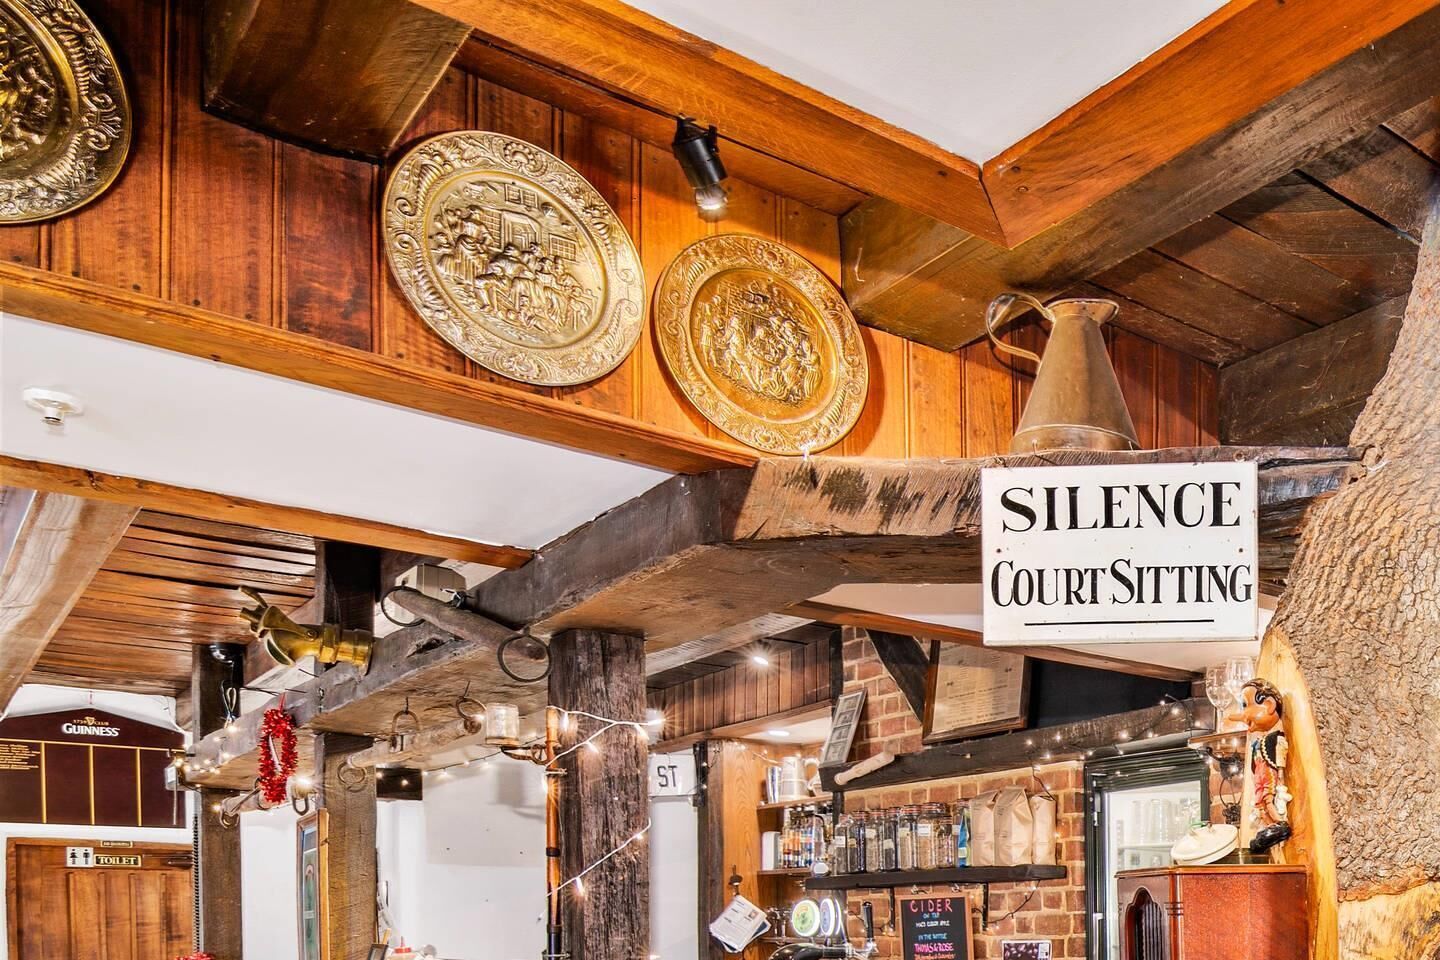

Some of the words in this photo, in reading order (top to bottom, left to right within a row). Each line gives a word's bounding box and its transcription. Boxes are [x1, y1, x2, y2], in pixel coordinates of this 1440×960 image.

[1000, 481, 1241, 533] SILENCE
[61, 722, 120, 737] GUINNESS
[657, 764, 678, 787] ST
[98, 856, 137, 865] TOILET
[910, 898, 953, 913] CIDER
